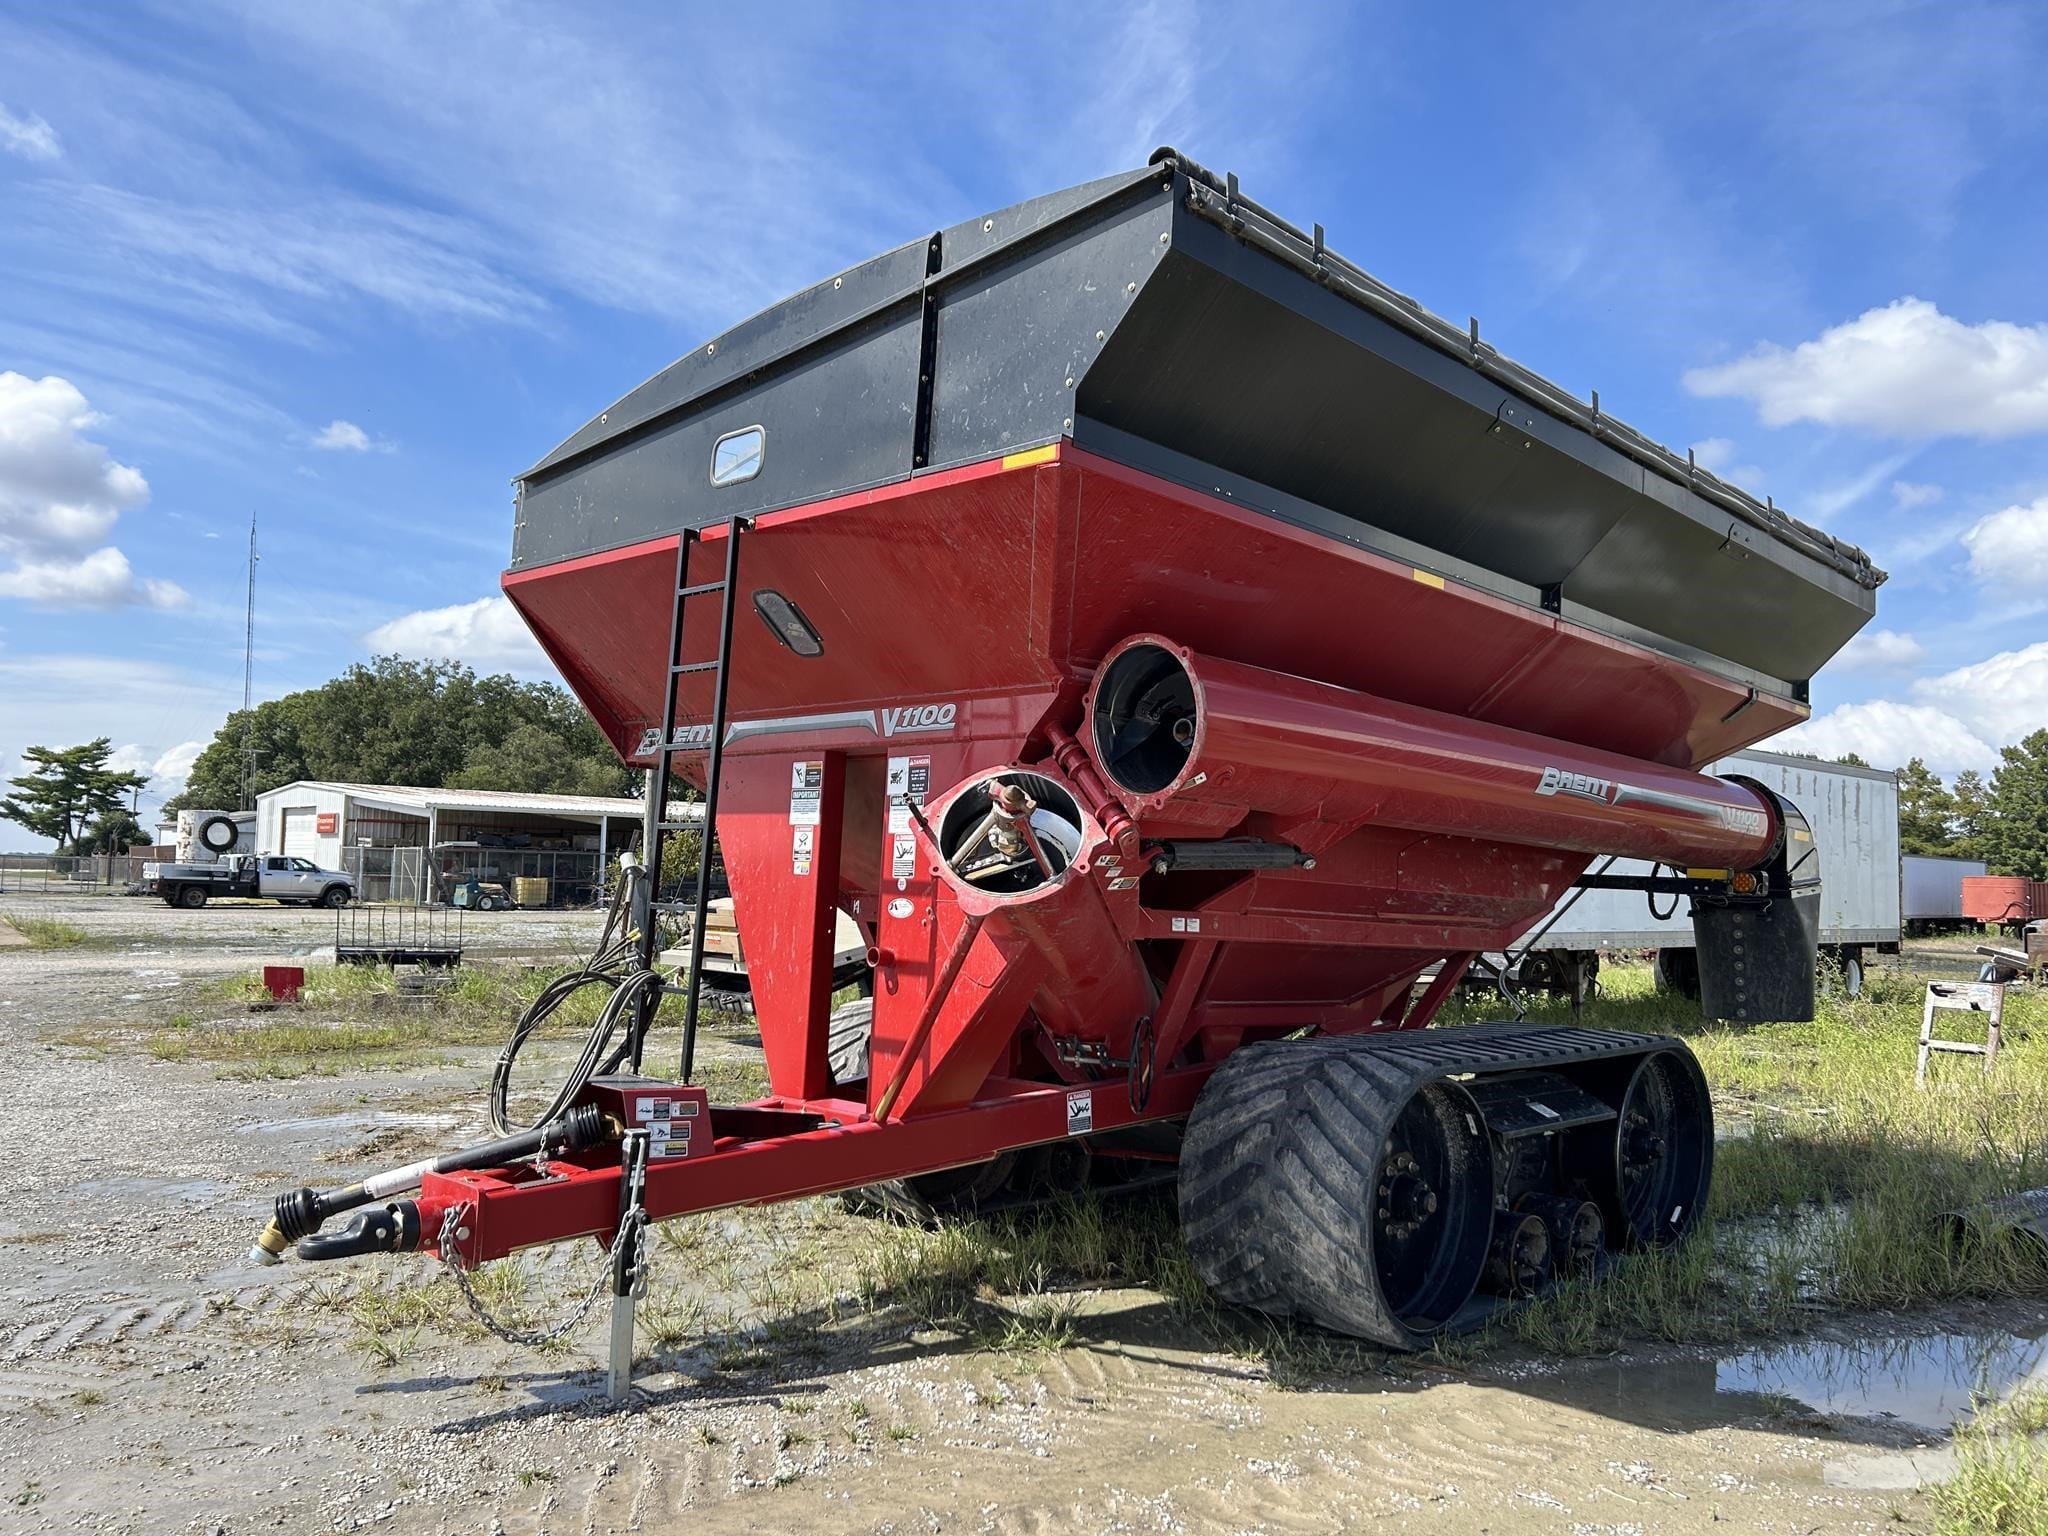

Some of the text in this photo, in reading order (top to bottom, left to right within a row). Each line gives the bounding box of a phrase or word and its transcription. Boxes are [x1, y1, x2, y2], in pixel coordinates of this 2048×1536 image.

[881, 703, 957, 737] V1100
[634, 724, 714, 756] BENT
[793, 791, 819, 799] IMPORTANT
[892, 796, 923, 806] IMPOANT
[1534, 766, 1612, 806] BRENT
